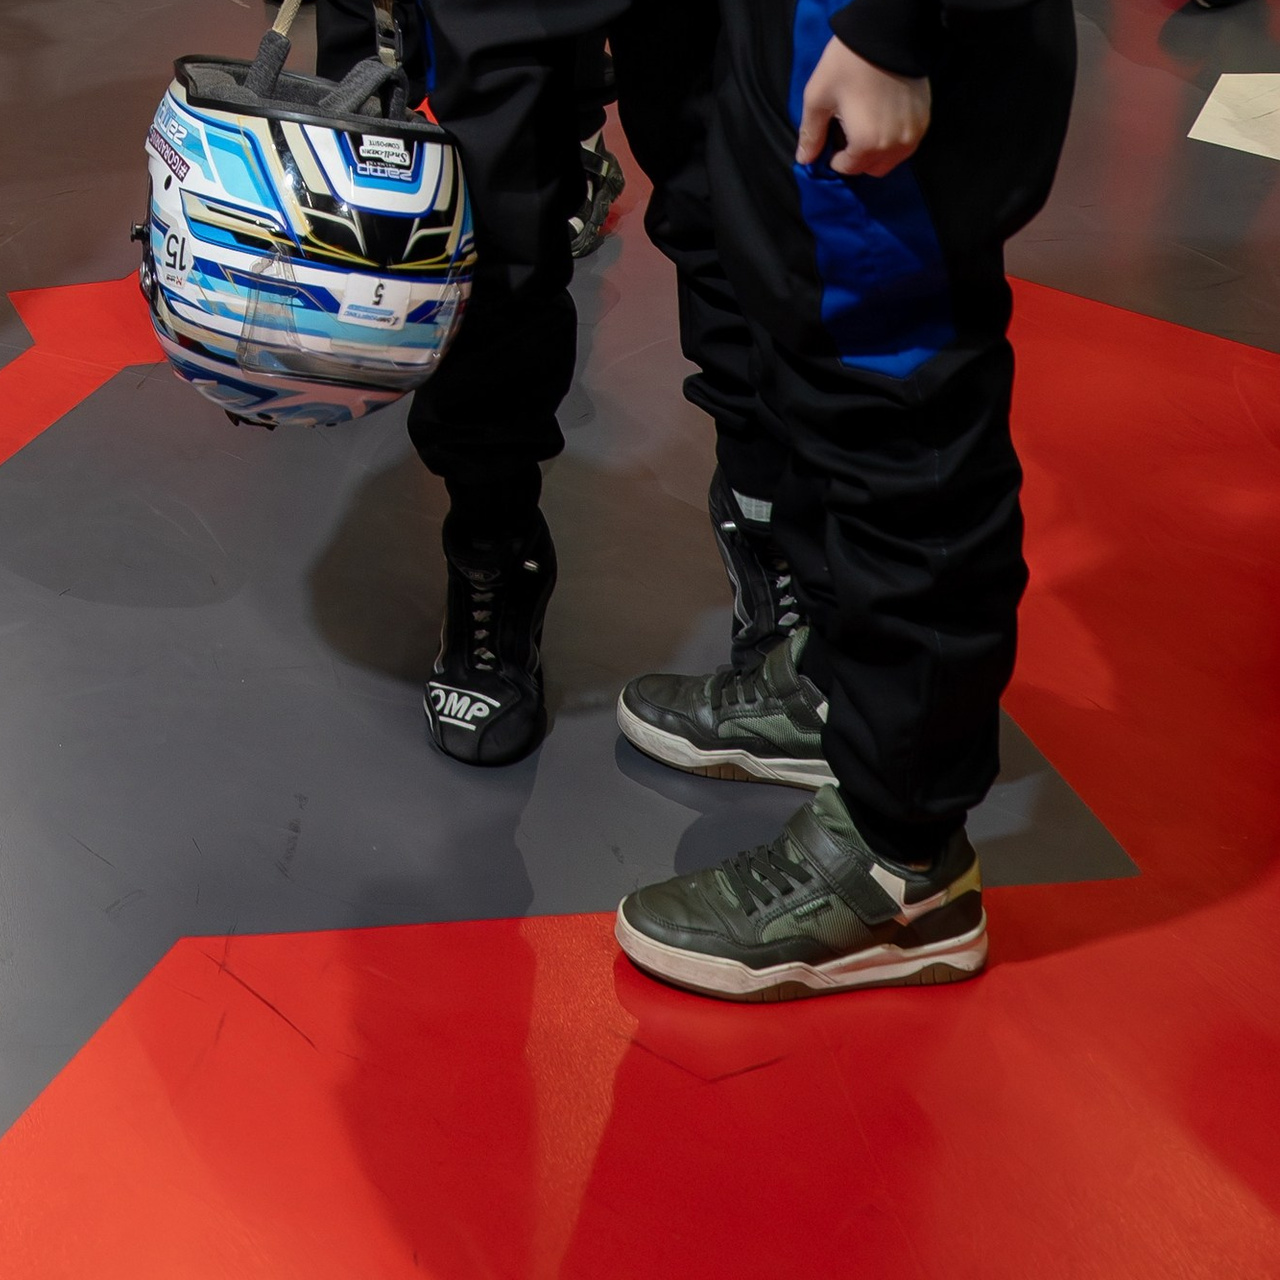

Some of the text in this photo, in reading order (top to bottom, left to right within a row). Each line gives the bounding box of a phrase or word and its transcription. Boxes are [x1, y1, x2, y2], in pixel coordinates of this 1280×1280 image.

[165, 233, 187, 271] 15
[372, 283, 385, 306] 5
[430, 688, 490, 721] OMP
